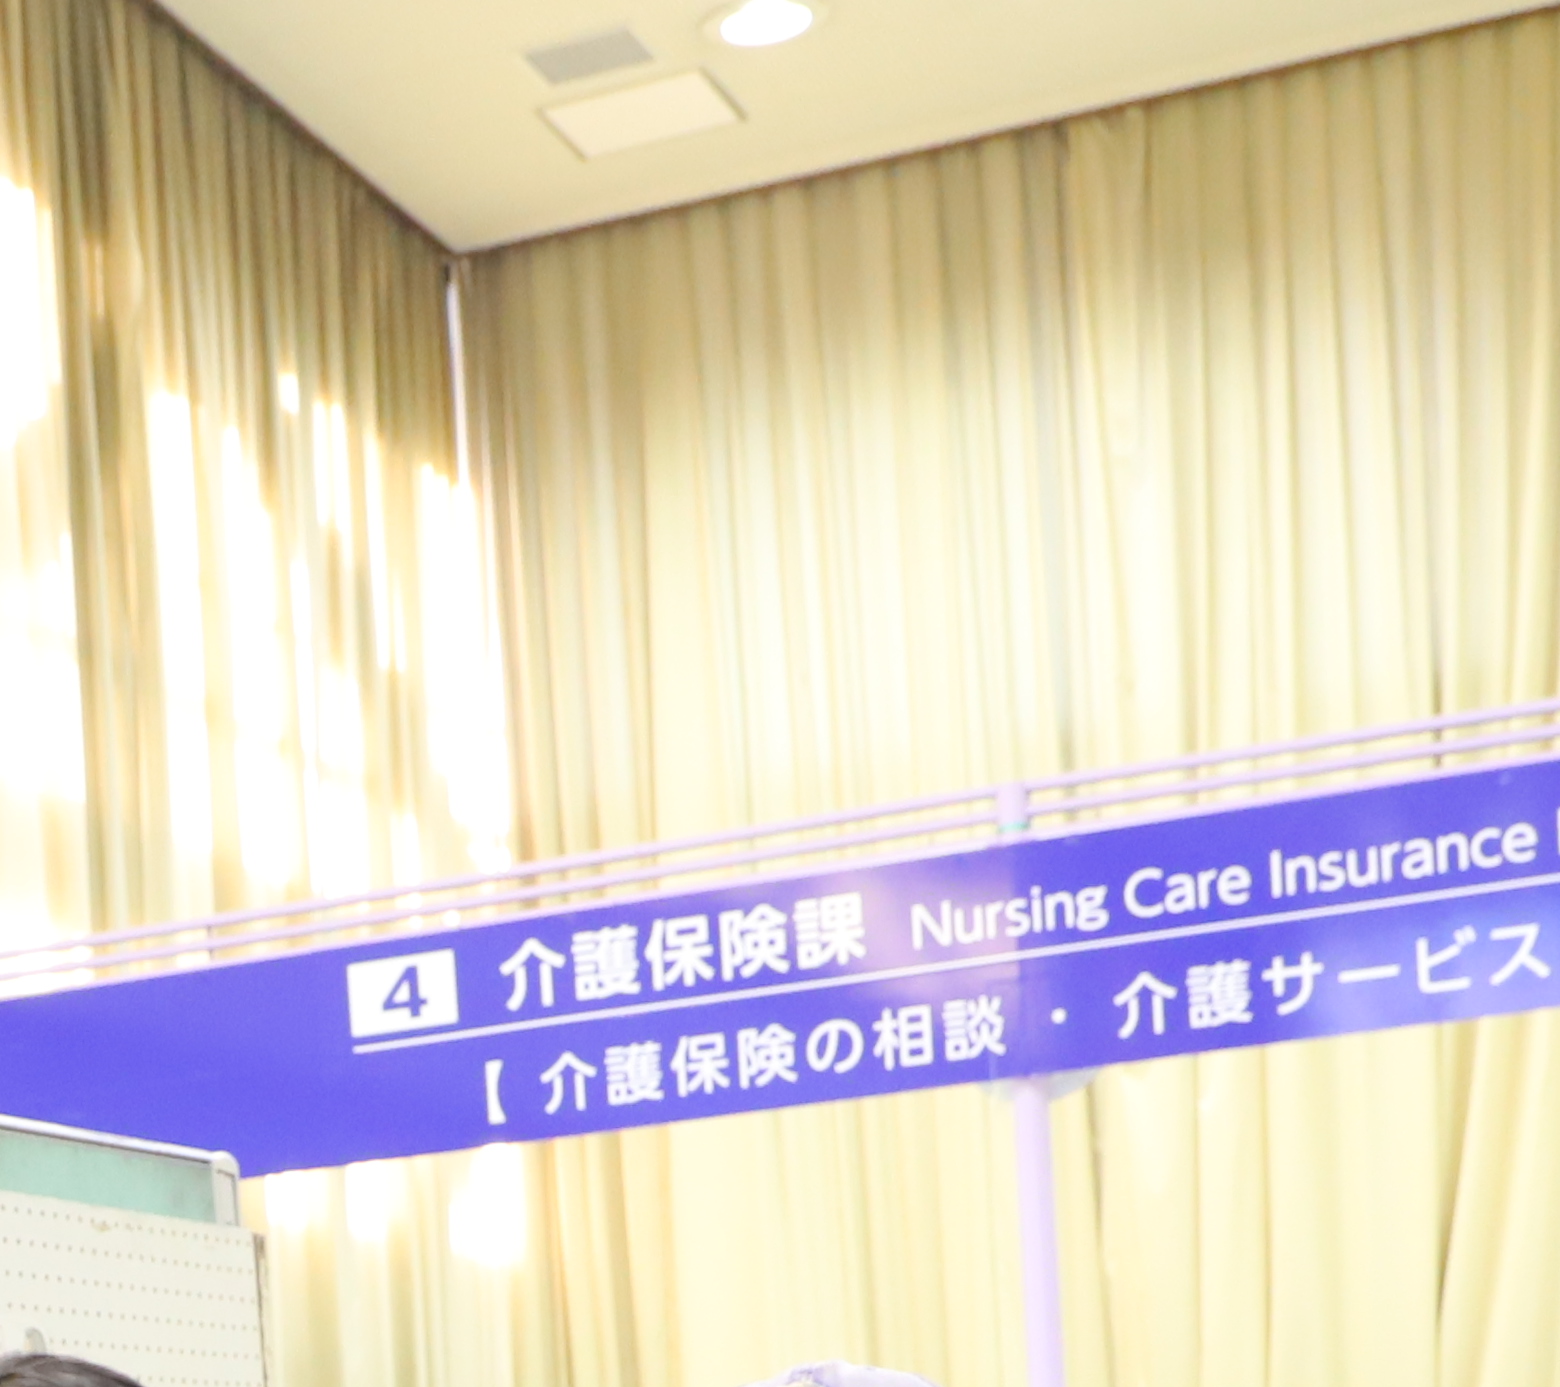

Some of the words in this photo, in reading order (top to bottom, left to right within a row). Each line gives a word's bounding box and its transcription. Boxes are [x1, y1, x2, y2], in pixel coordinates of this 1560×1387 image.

[382, 964, 428, 1020] 4
[499, 892, 867, 1013] 介護保険課
[910, 885, 1110, 950] Nursing
[1123, 866, 1253, 918] Care
[1269, 822, 1539, 899] Insurance
[539, 994, 1007, 1116] 介護保険の相談
[1112, 922, 1552, 1040] 介護サービス
